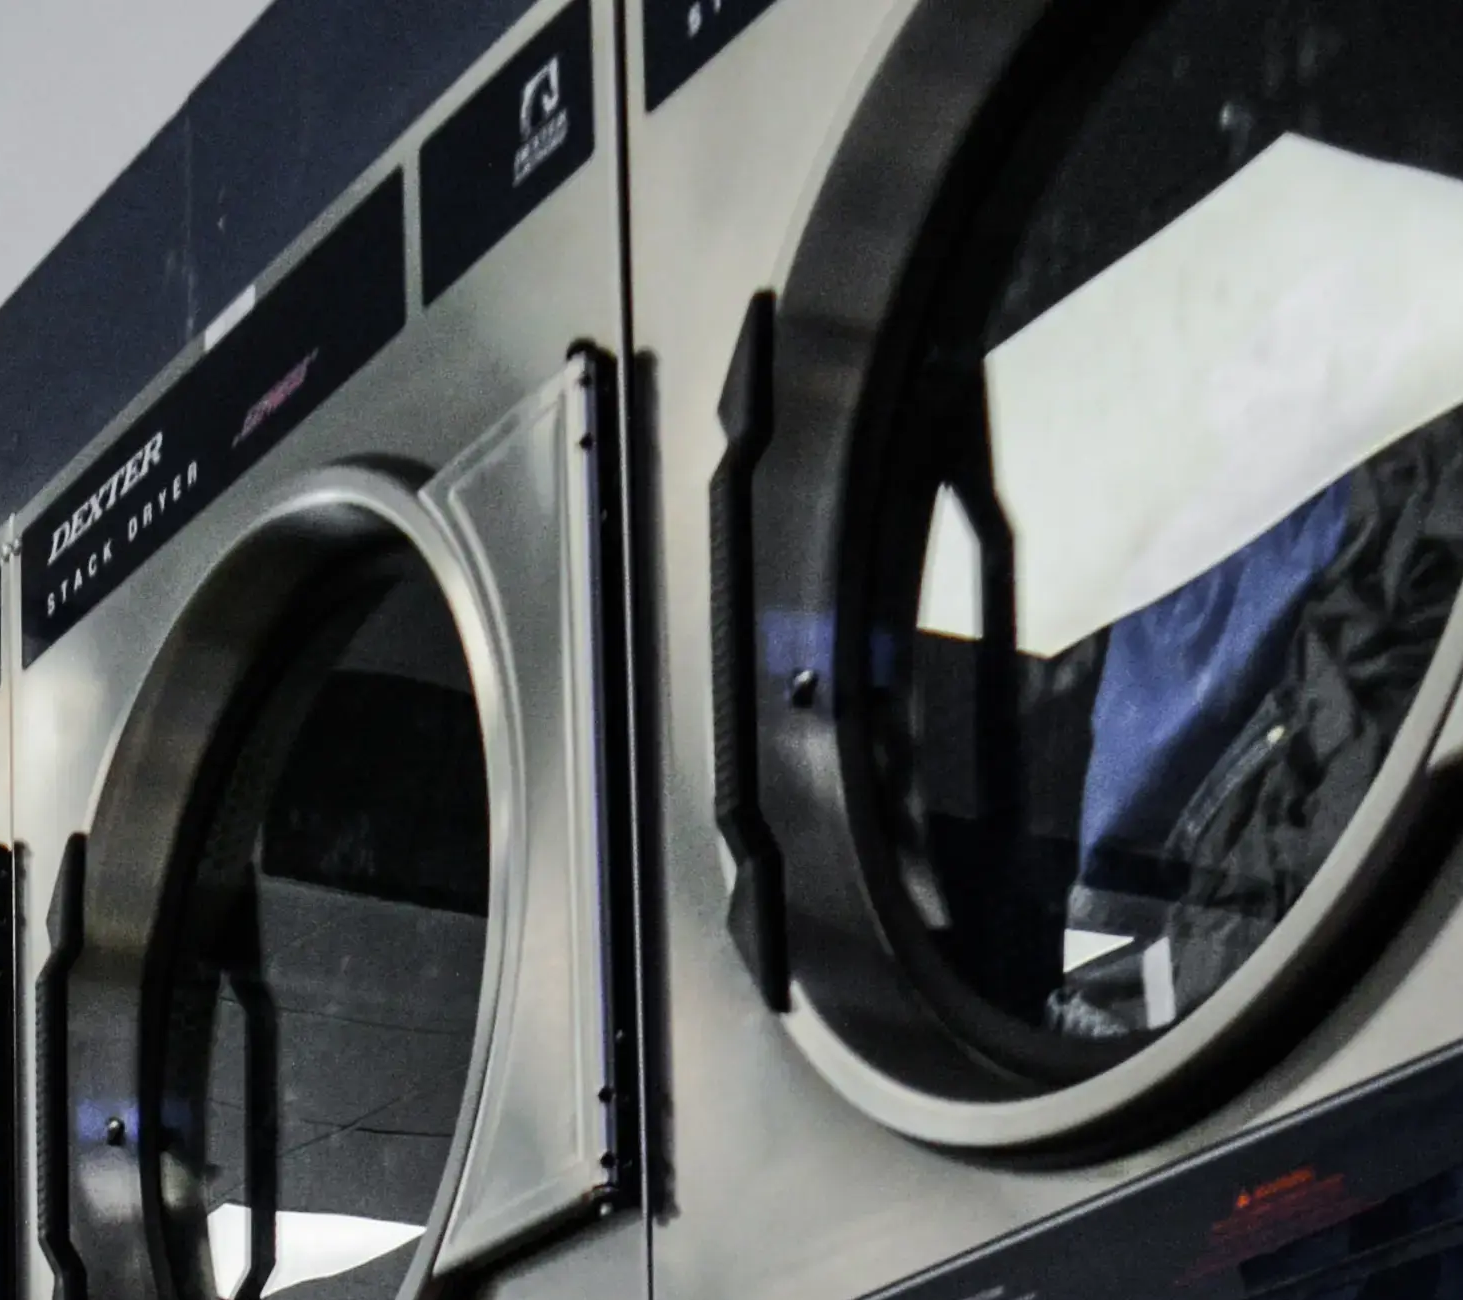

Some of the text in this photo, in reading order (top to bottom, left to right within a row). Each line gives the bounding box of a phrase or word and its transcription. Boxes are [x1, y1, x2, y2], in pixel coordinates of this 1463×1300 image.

[47, 430, 164, 567] DEXTER
[47, 460, 198, 618] STACK DRYER
